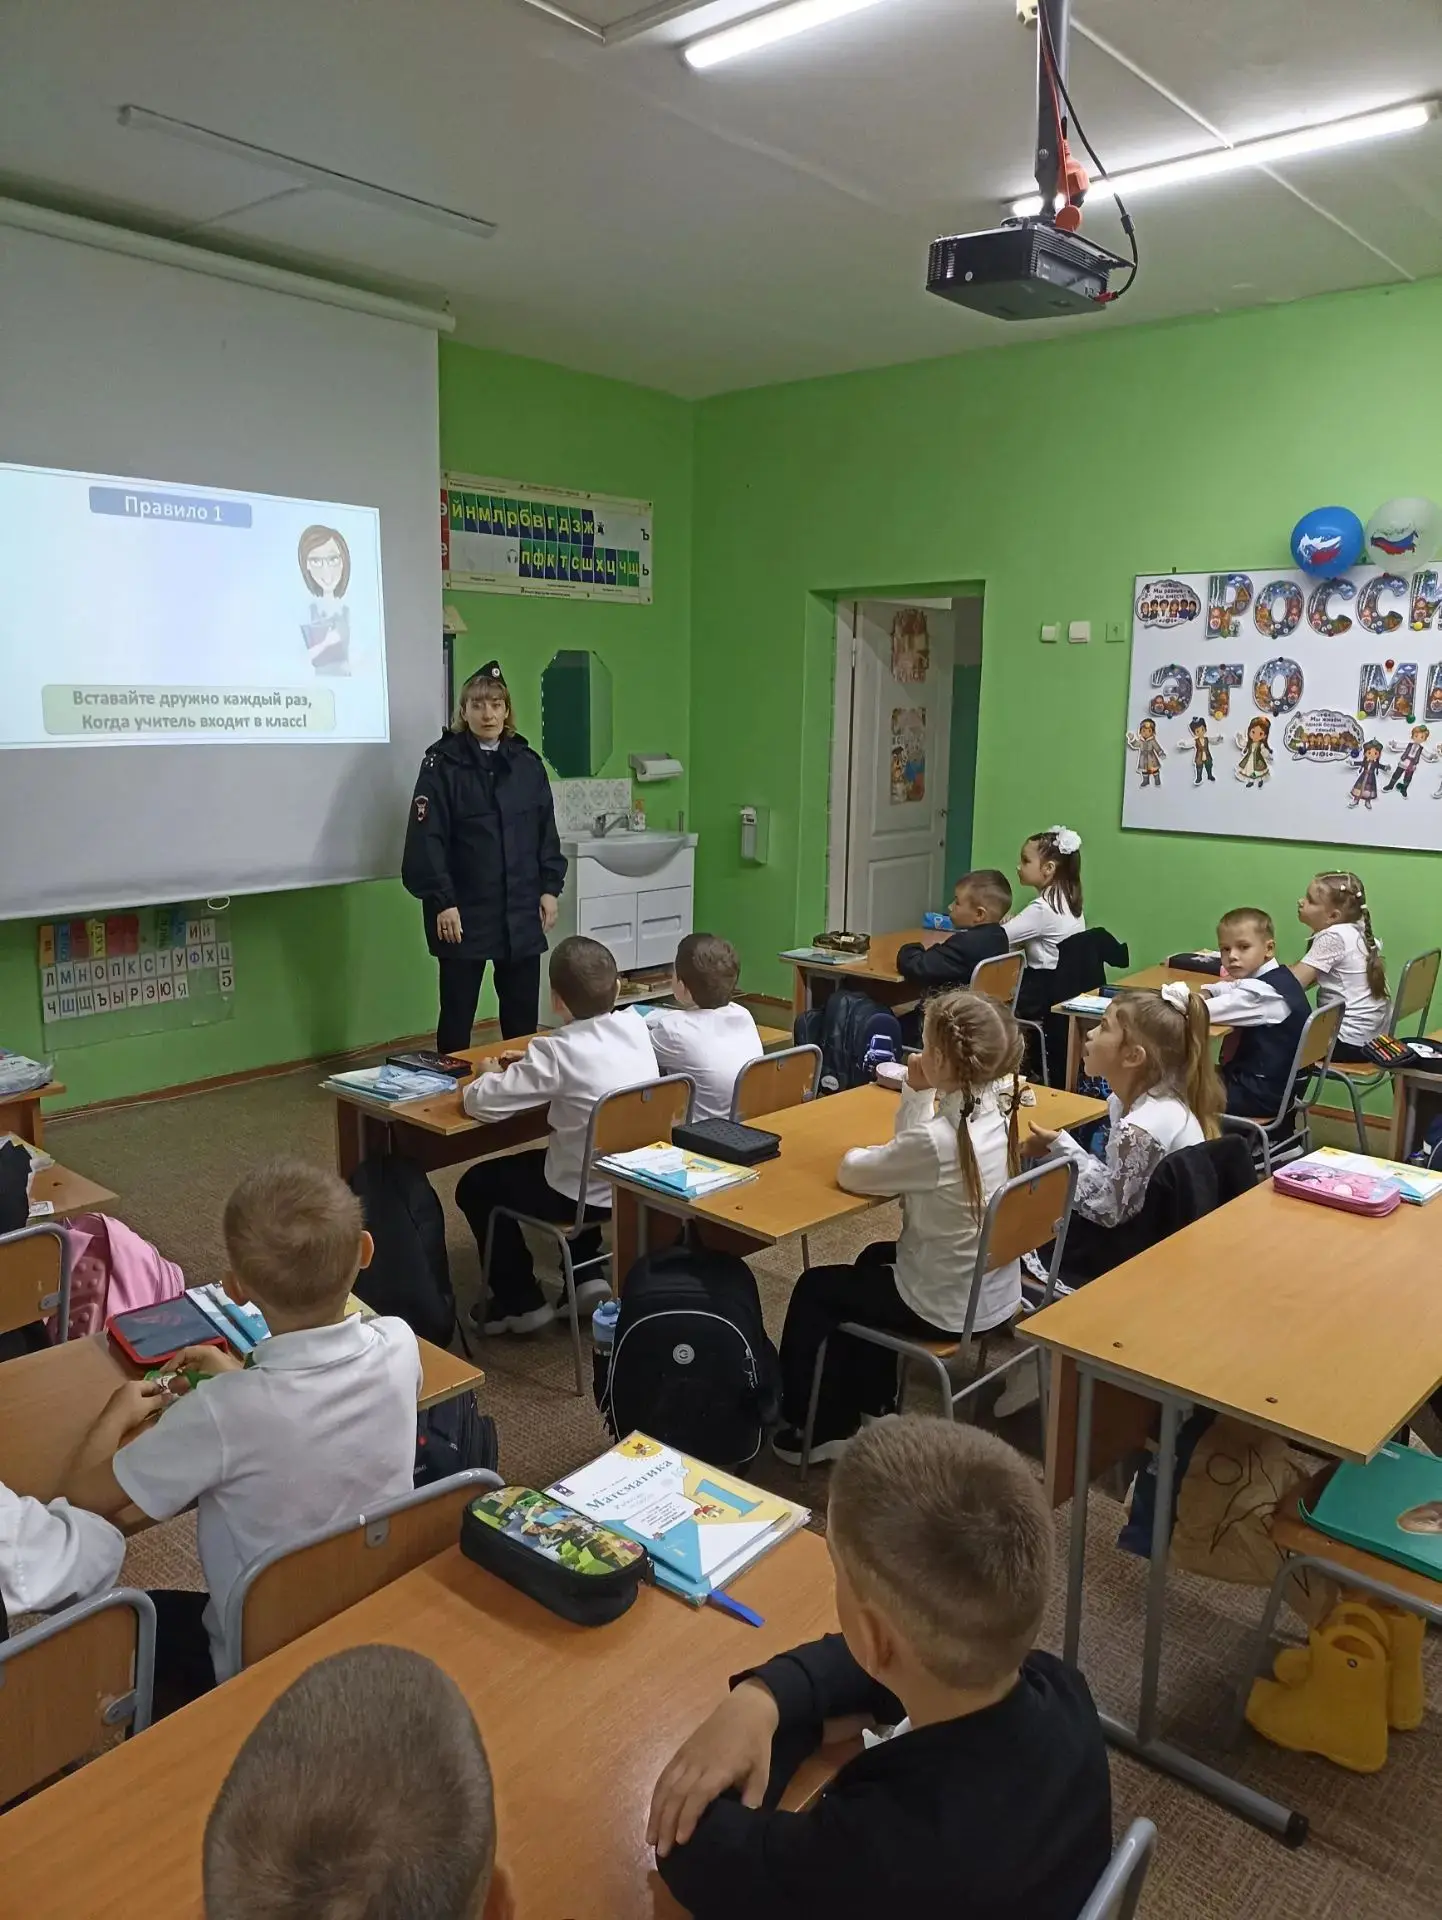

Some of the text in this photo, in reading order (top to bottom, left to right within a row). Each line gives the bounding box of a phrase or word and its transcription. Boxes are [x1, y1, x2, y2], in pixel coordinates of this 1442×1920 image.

[125, 495, 223, 521] Правило 1
[73, 690, 312, 709] Вставайте дружно каждый раз,
[1150, 658, 1305, 719] ЭТО
[82, 714, 307, 732] Когда учитель входит в класс!
[222, 970, 232, 987] 5
[585, 1459, 674, 1511] Математика
